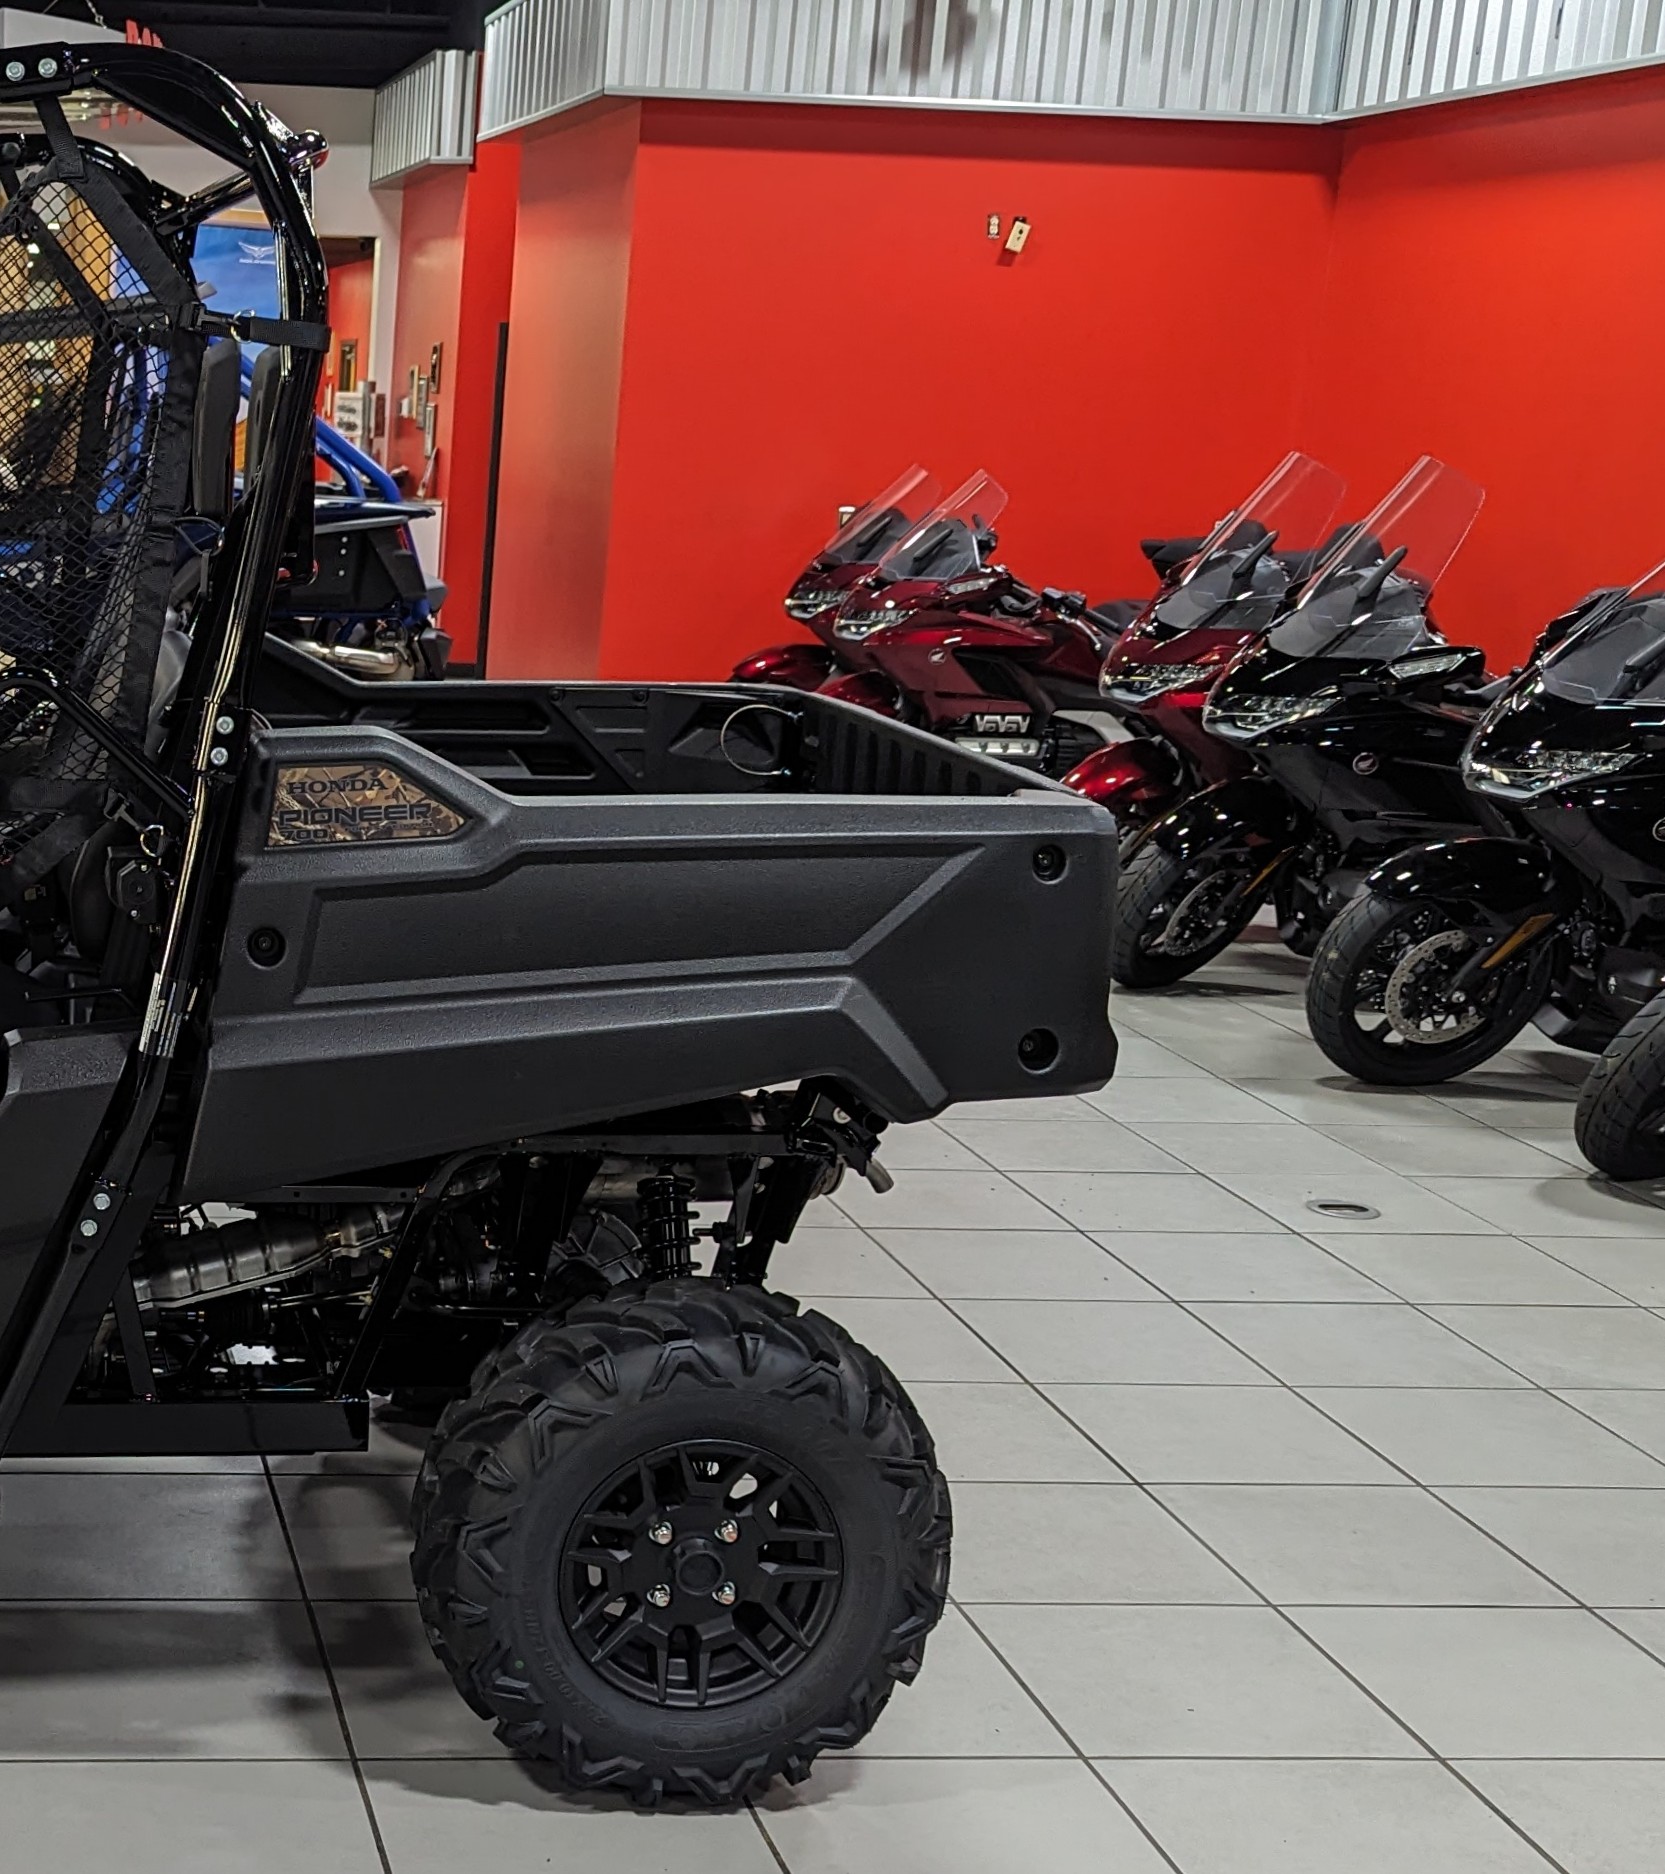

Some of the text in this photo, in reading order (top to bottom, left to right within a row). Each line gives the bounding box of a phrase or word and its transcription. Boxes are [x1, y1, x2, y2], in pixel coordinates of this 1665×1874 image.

[288, 778, 388, 794] HONDA
[278, 804, 433, 826] PIONEER
[280, 829, 330, 841] 700
